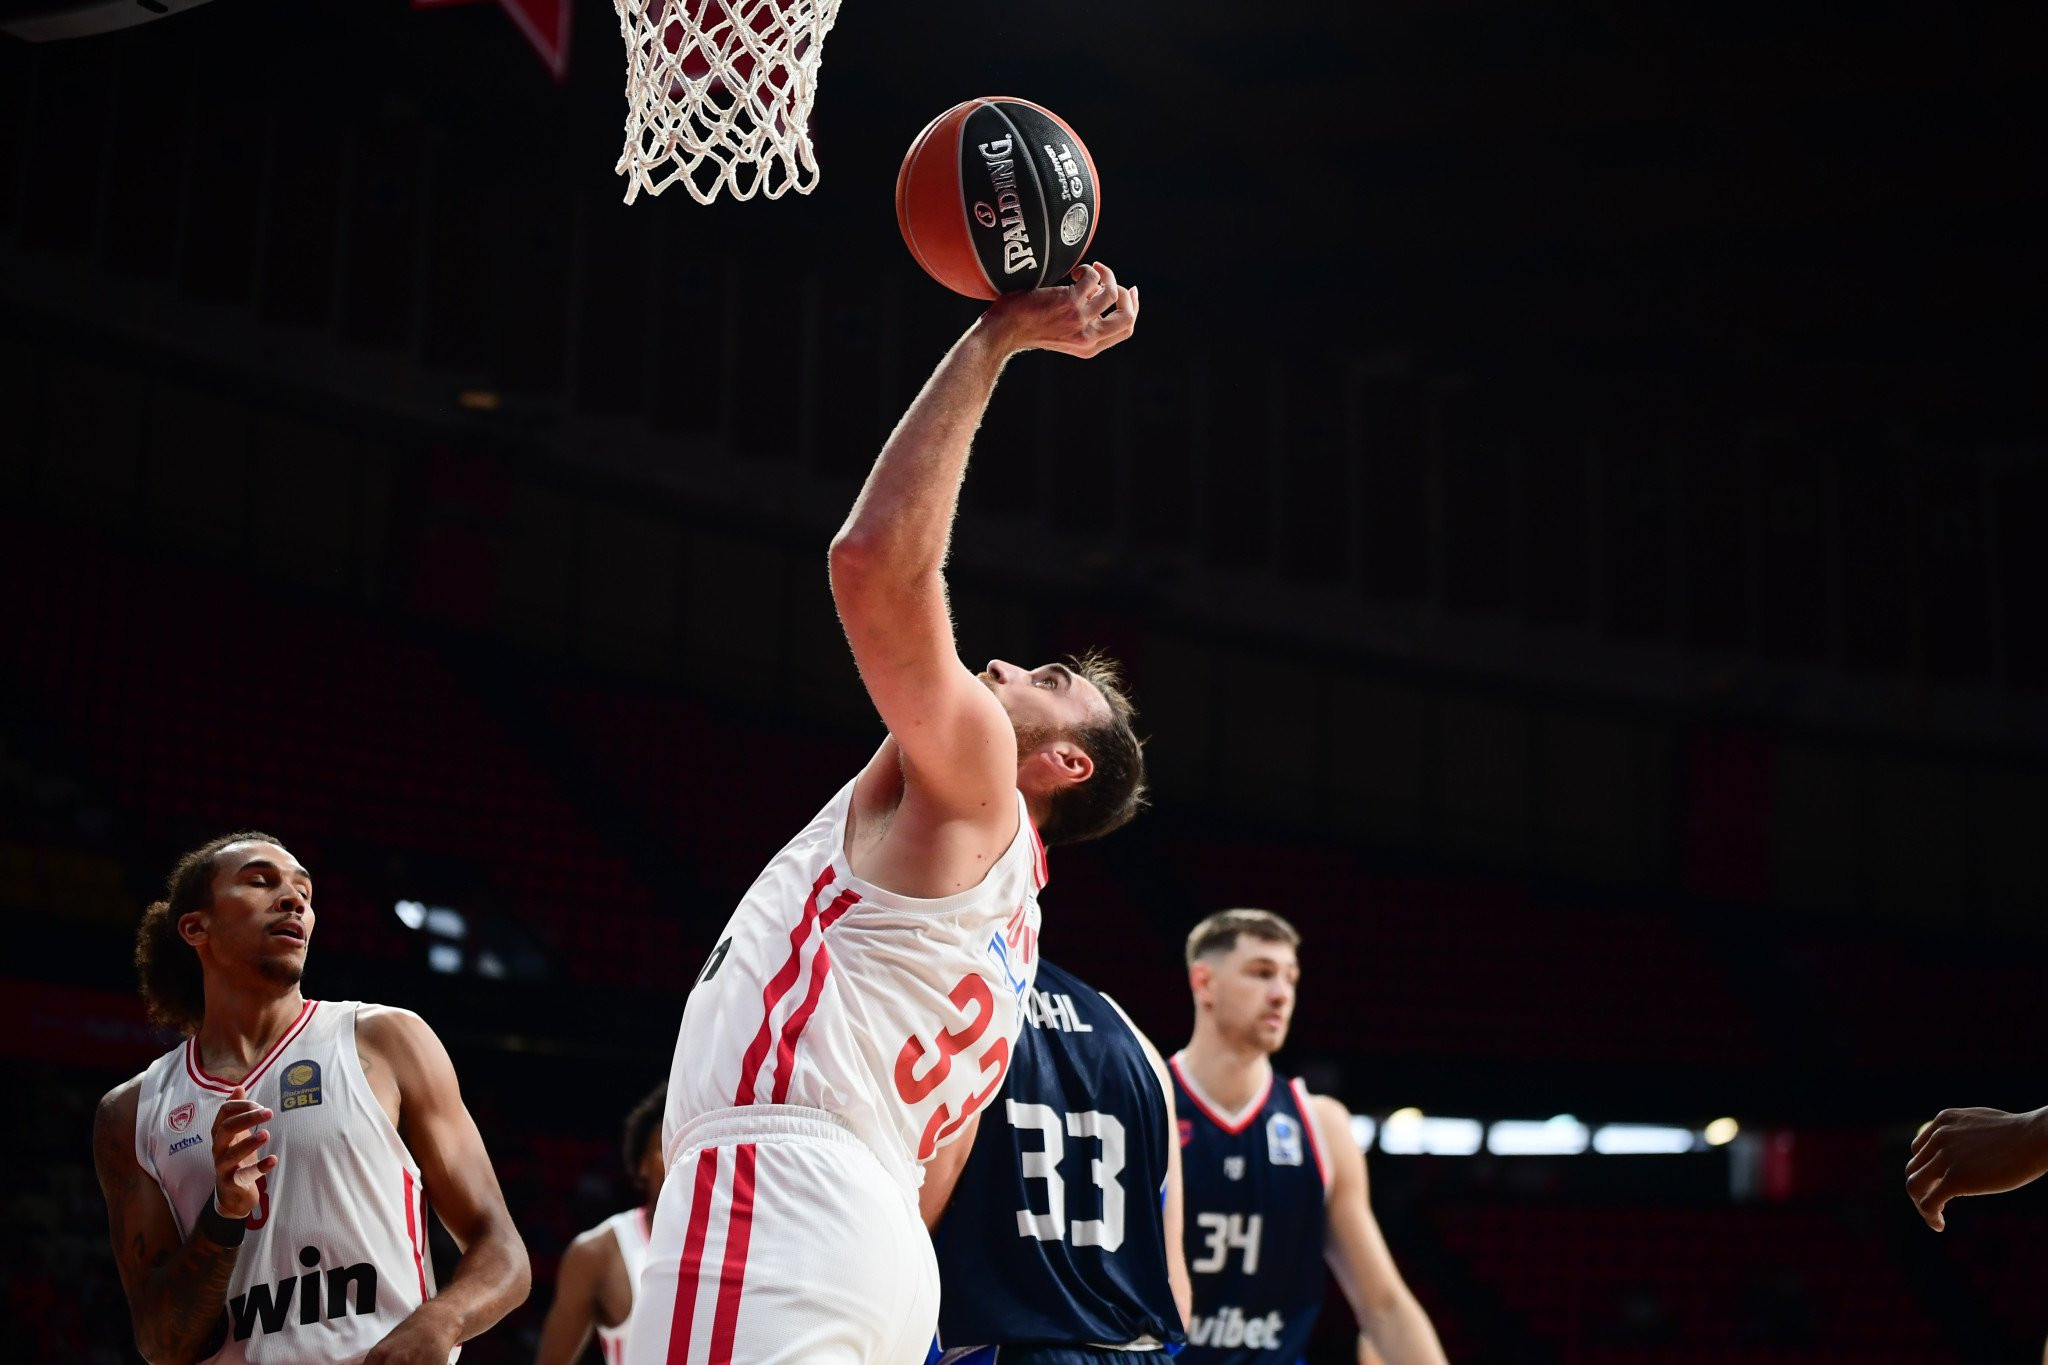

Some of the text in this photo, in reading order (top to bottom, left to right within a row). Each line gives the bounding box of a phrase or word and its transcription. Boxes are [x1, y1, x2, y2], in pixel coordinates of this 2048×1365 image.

[1057, 143, 1084, 199] GBL
[1023, 986, 1093, 1033] AHL
[894, 972, 1009, 1161] 33
[283, 1093, 319, 1109] GBL
[1005, 1098, 1126, 1253] 33
[1192, 1211, 1262, 1276] 34
[1187, 1306, 1284, 1351] vibet
